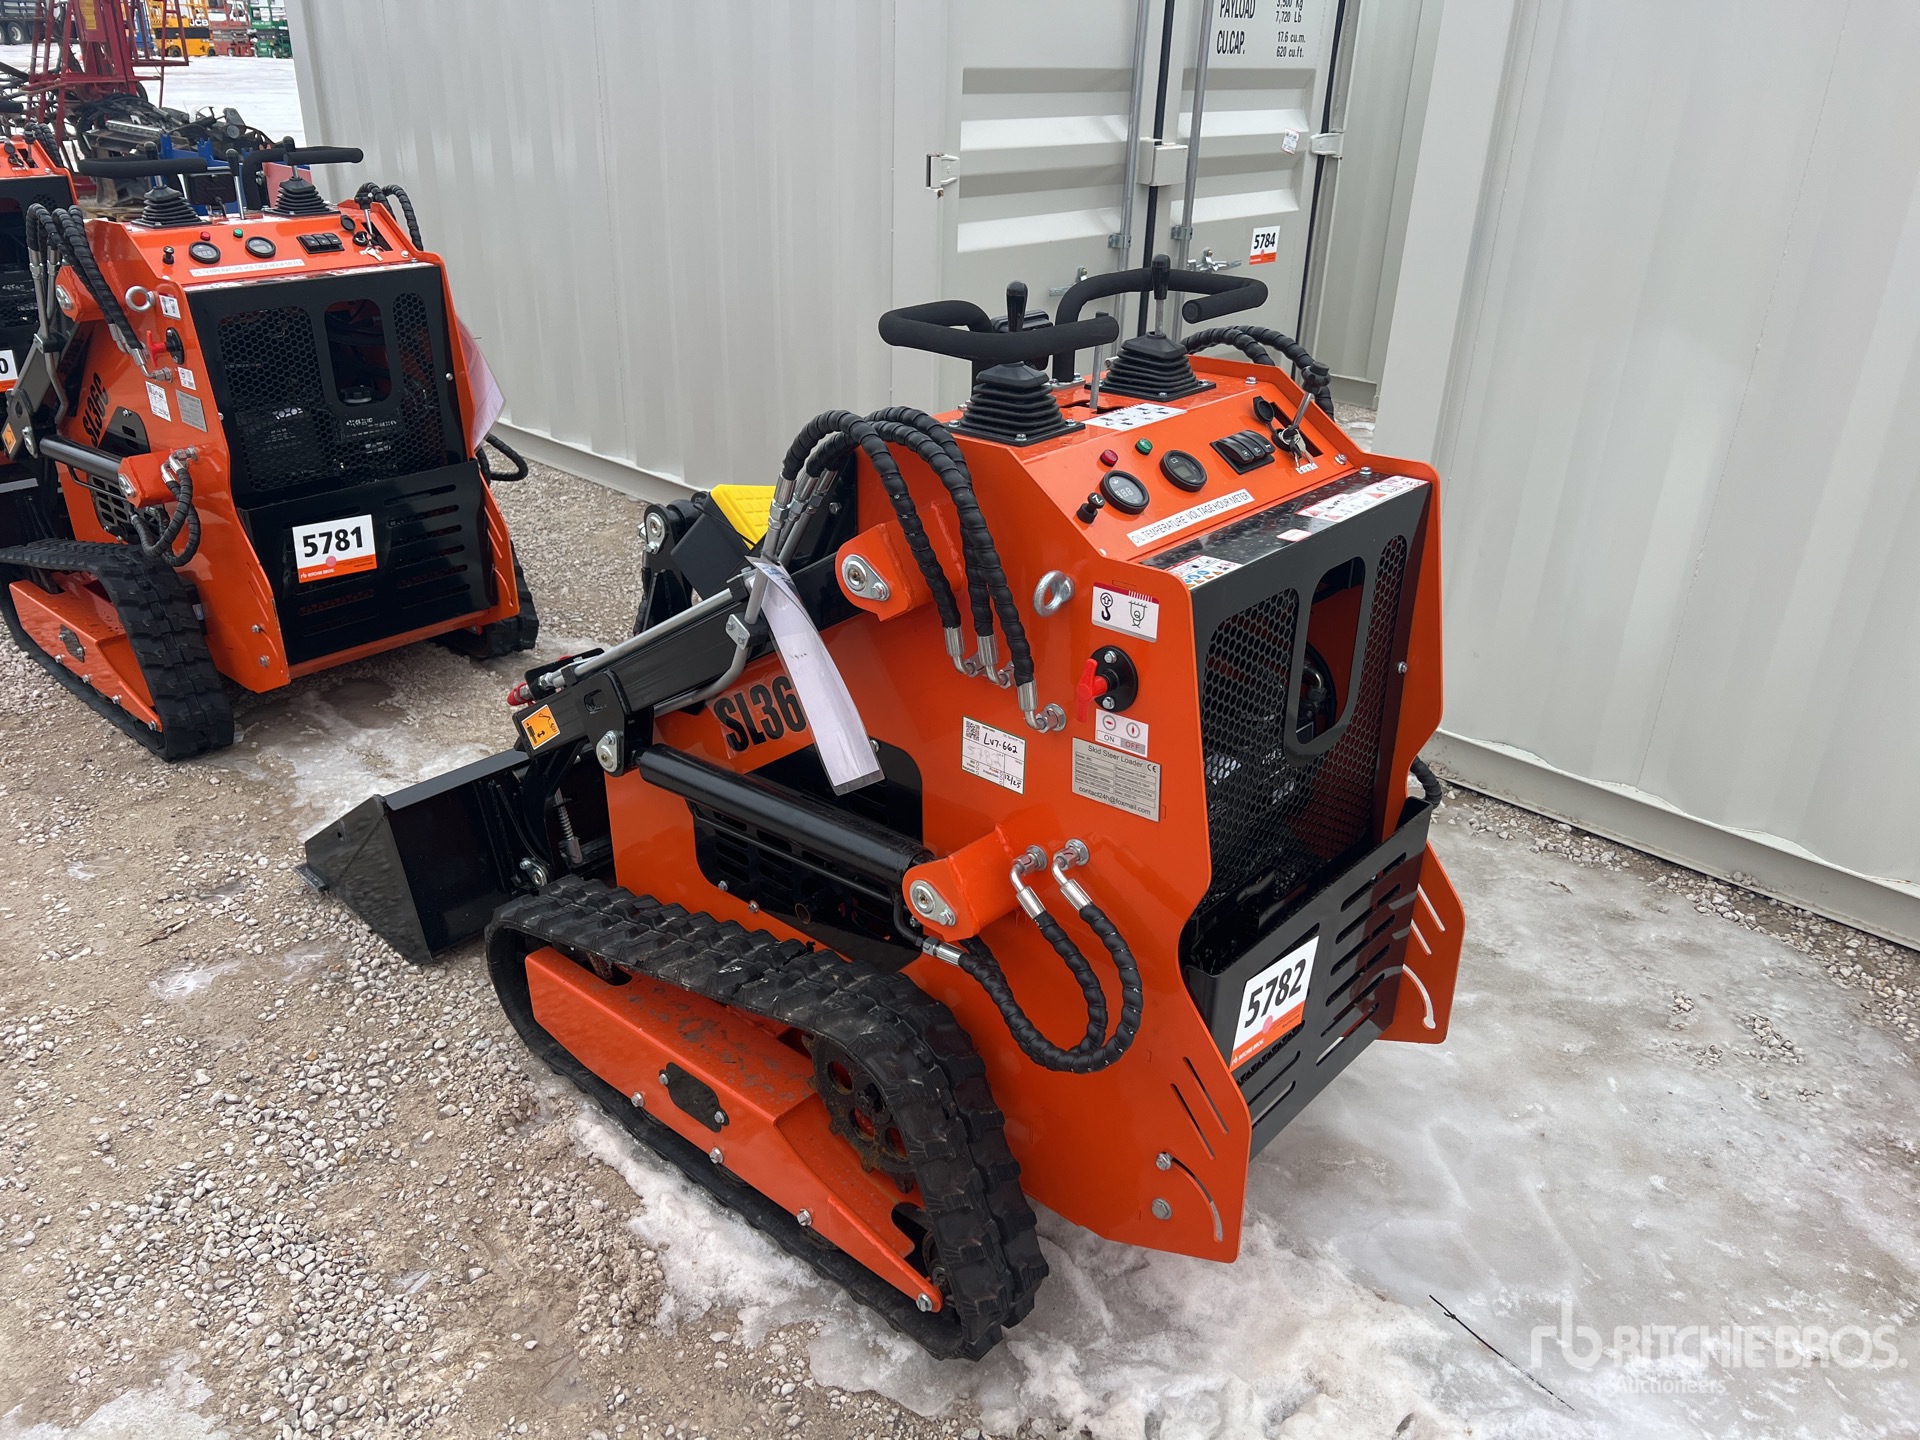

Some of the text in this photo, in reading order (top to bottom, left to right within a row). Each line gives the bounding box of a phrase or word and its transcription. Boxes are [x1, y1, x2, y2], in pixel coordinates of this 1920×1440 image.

[1220, 0, 1256, 18] PAYLOAD
[1275, 11, 1301, 24] 7,720 Lb
[189, 19, 209, 27] JCB
[1216, 30, 1245, 54] CU.CAP.
[1277, 31, 1288, 42] 17.6
[1276, 46, 1287, 57] 620
[1253, 232, 1276, 250] 5784
[1131, 531, 1146, 544] OIL
[1142, 516, 1188, 538] TEMPERATURE
[1186, 503, 1215, 520] VOLTAGE
[1229, 491, 1251, 504] METER
[302, 526, 363, 558] 5781
[713, 676, 807, 751] SL36
[1104, 734, 1140, 750] ON OFF
[1088, 745, 1101, 755] Skid
[1102, 749, 1120, 760] Steer
[1121, 755, 1143, 768] Loader
[1244, 958, 1306, 1029] 5782
